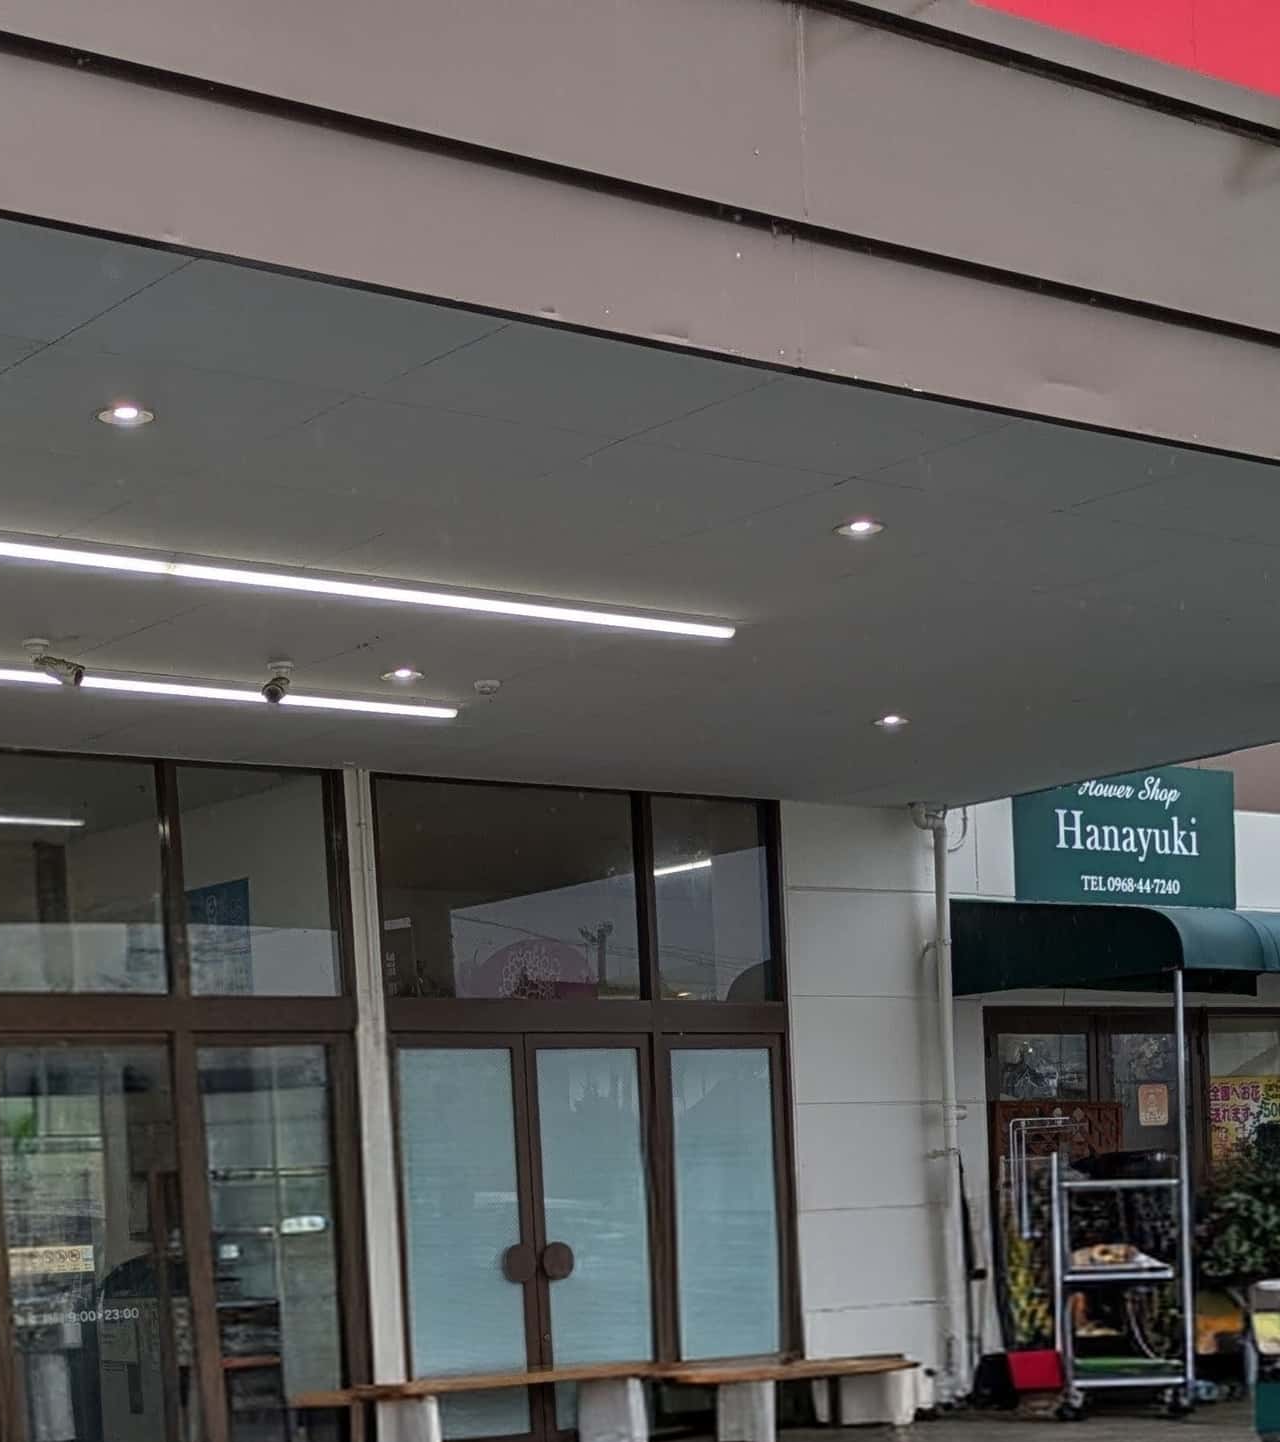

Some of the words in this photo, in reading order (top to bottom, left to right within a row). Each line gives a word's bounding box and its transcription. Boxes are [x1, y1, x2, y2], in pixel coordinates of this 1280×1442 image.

[1138, 776, 1181, 809] Shop
[1055, 809, 1200, 862] Hanayuki
[1081, 875, 1106, 891] TEL
[104, 1307, 140, 1320] 23:00
